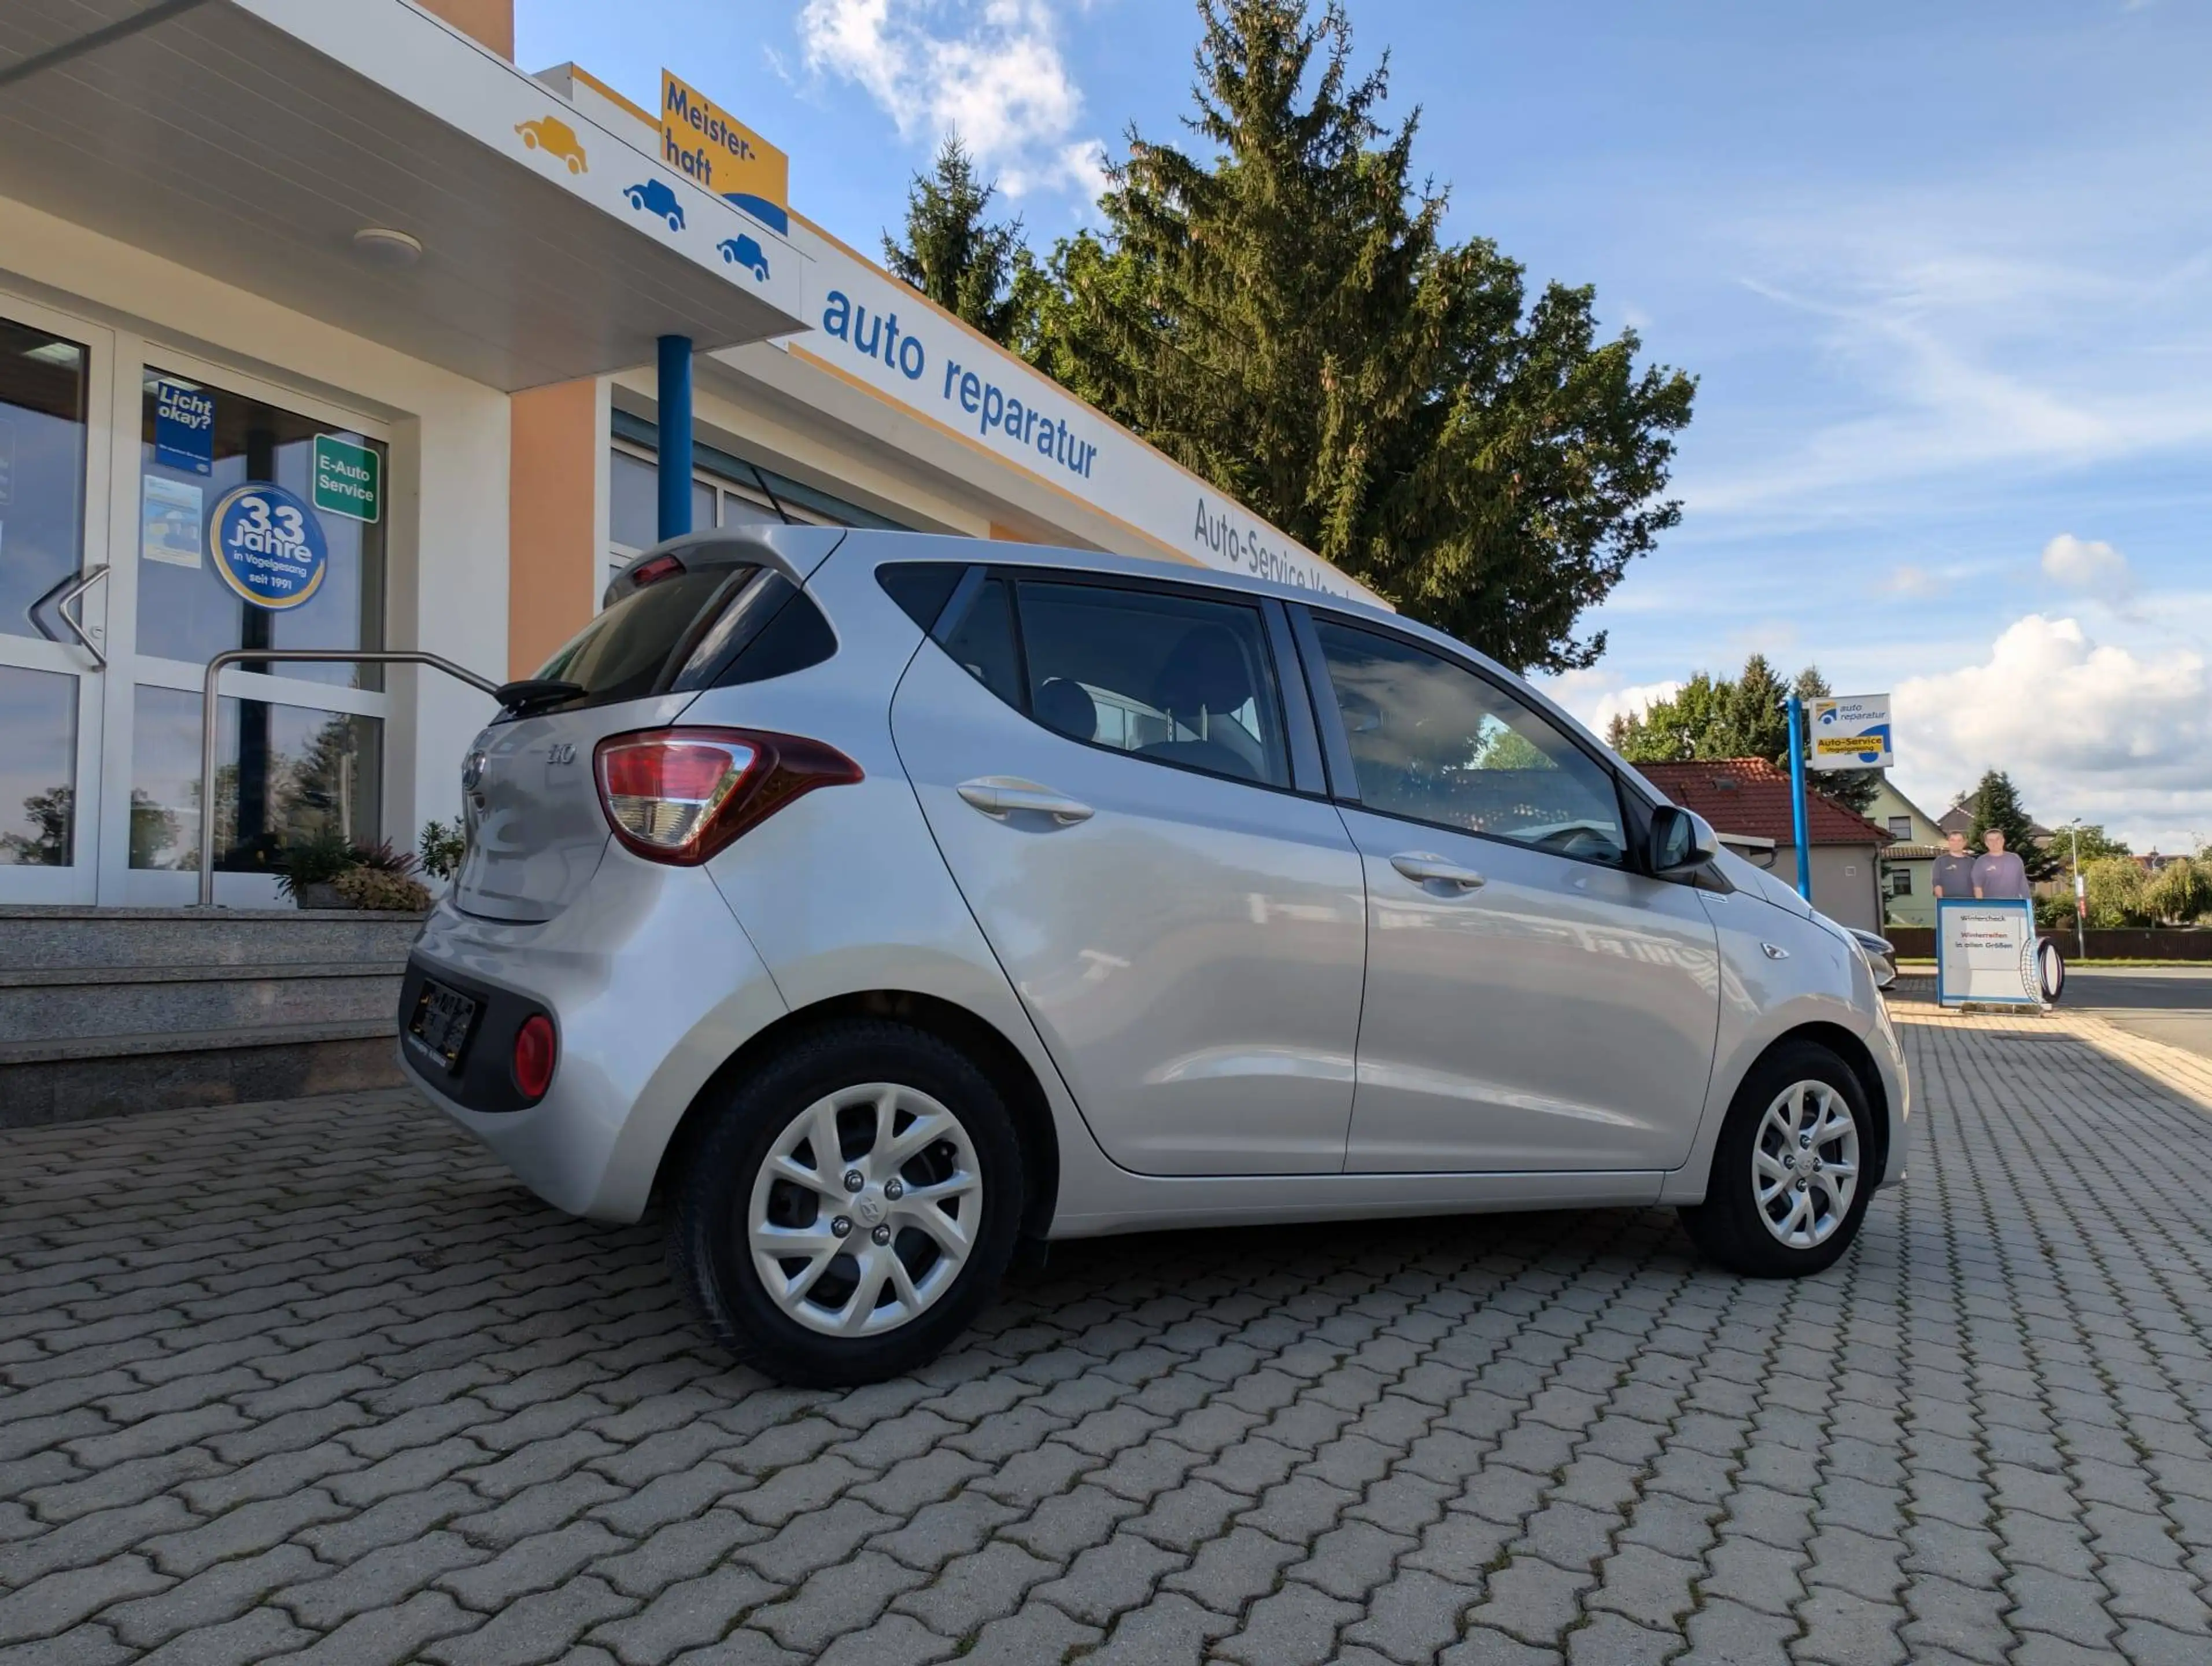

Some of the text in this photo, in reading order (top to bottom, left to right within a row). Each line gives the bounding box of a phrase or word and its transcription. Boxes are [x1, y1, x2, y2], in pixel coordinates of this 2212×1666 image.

[667, 80, 755, 161] Meister-
[666, 127, 712, 186] haft
[823, 290, 1097, 478] auto reparatur
[159, 386, 213, 416] Licht
[158, 405, 212, 430] okay?
[320, 454, 371, 482] E-Auto
[319, 474, 374, 502] Service
[241, 496, 305, 545] 33
[228, 524, 312, 563] Jahre
[1195, 497, 1305, 585] Auto-Service
[234, 550, 307, 578] in Vogelgesang
[249, 573, 293, 590] seit 1991
[1840, 703, 1863, 712] auto
[1840, 711, 1886, 723] reparatur
[1818, 736, 1882, 747] Auto-Service
